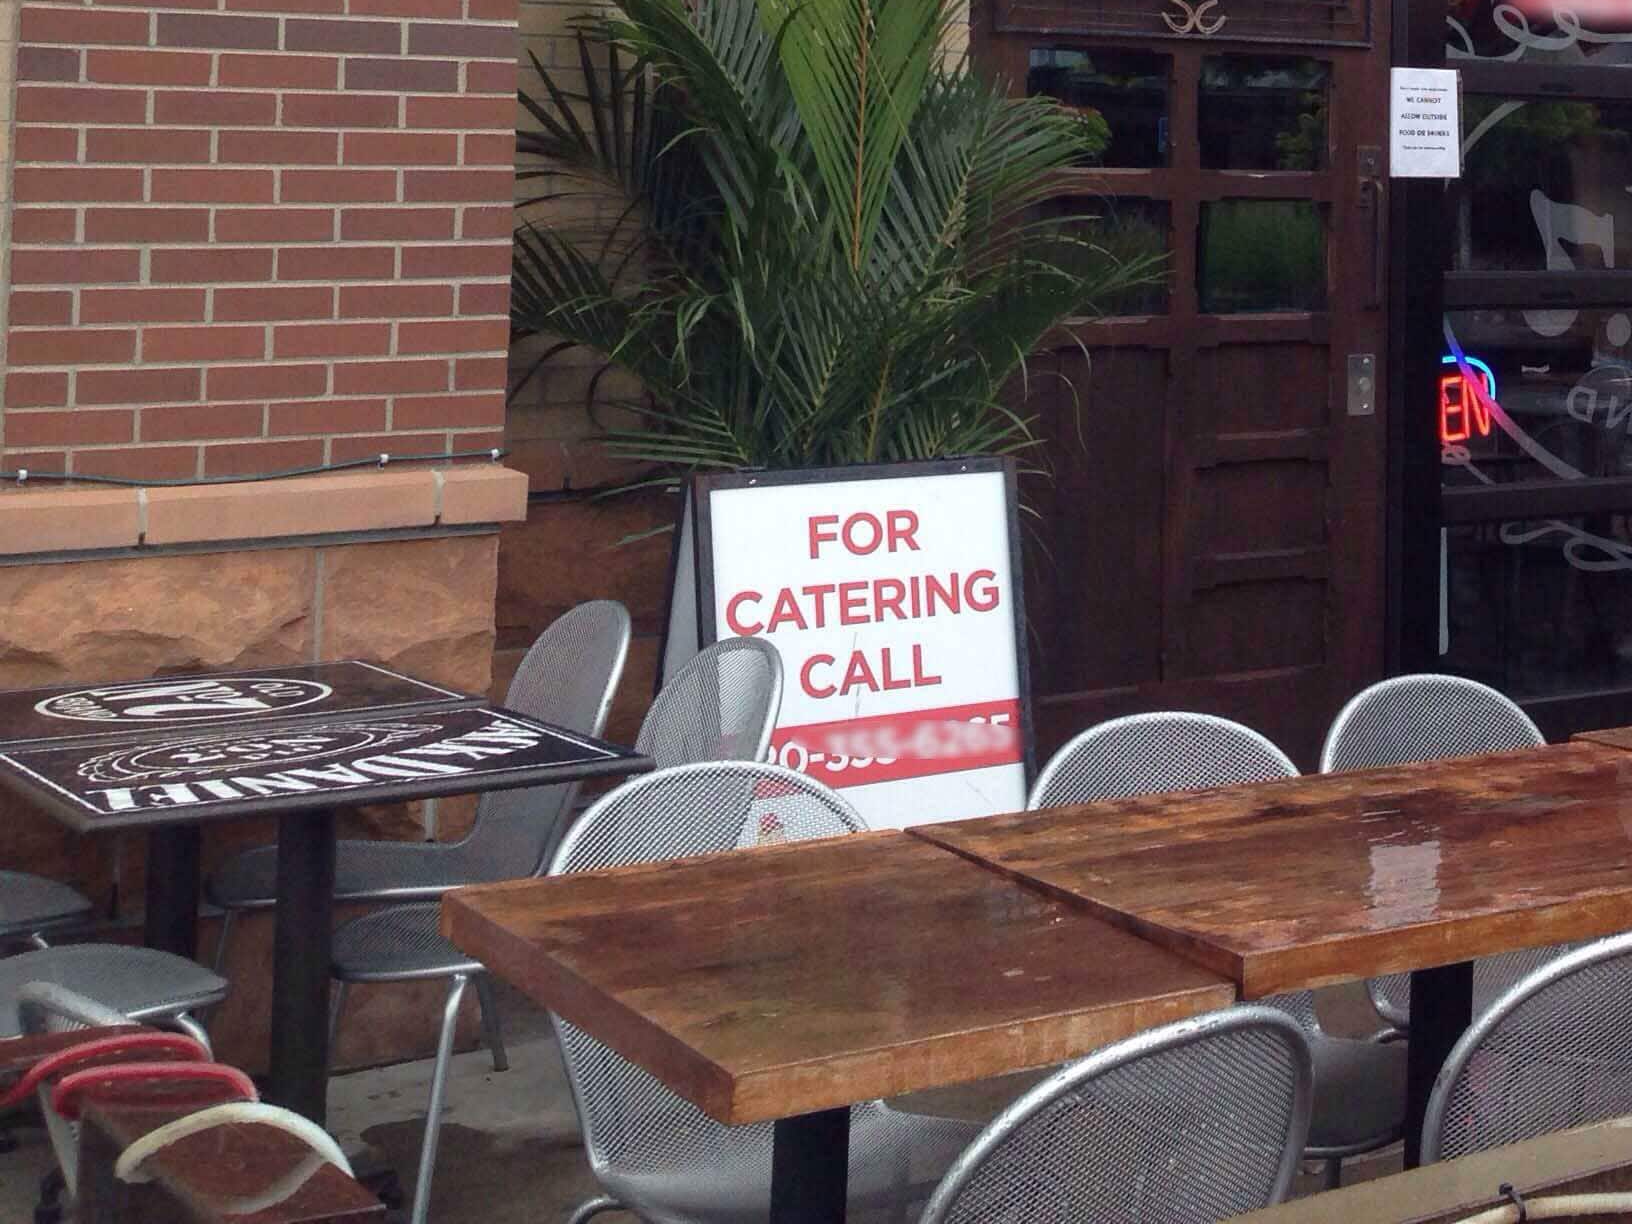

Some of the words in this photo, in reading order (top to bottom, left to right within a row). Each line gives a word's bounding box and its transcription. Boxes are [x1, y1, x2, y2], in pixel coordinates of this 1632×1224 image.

[1441, 373, 1490, 442] EN
[808, 509, 921, 560] FOR
[725, 569, 1000, 638] CATERING
[799, 643, 943, 700] CALL
